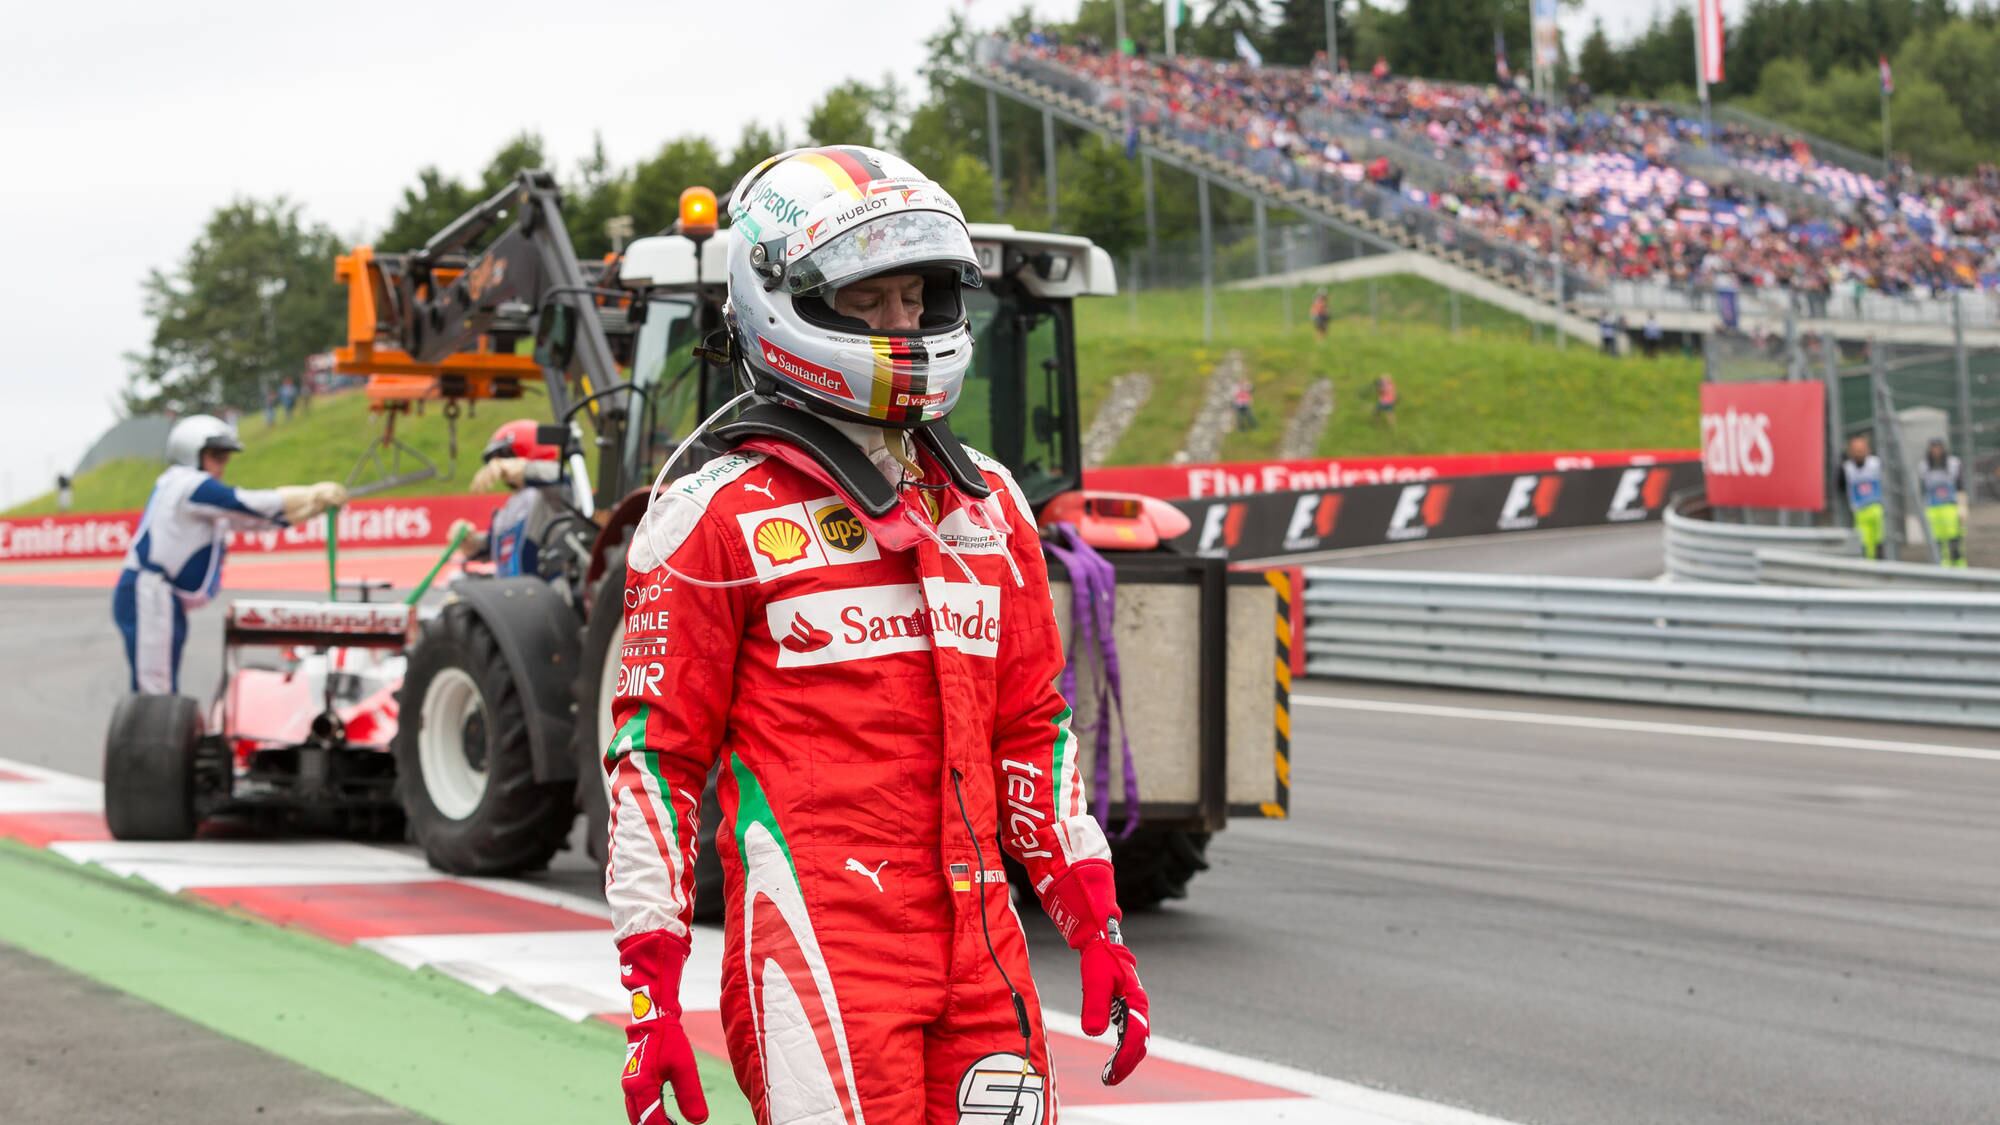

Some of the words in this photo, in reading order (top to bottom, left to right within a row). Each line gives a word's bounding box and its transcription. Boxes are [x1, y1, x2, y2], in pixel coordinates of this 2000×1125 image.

[836, 197, 889, 225] HUBLOT
[778, 353, 841, 391] Santander
[821, 517, 863, 547] ups
[940, 533, 988, 543] SCUDERIA
[271, 608, 402, 632] Santander
[957, 1069, 1046, 1125] 5
